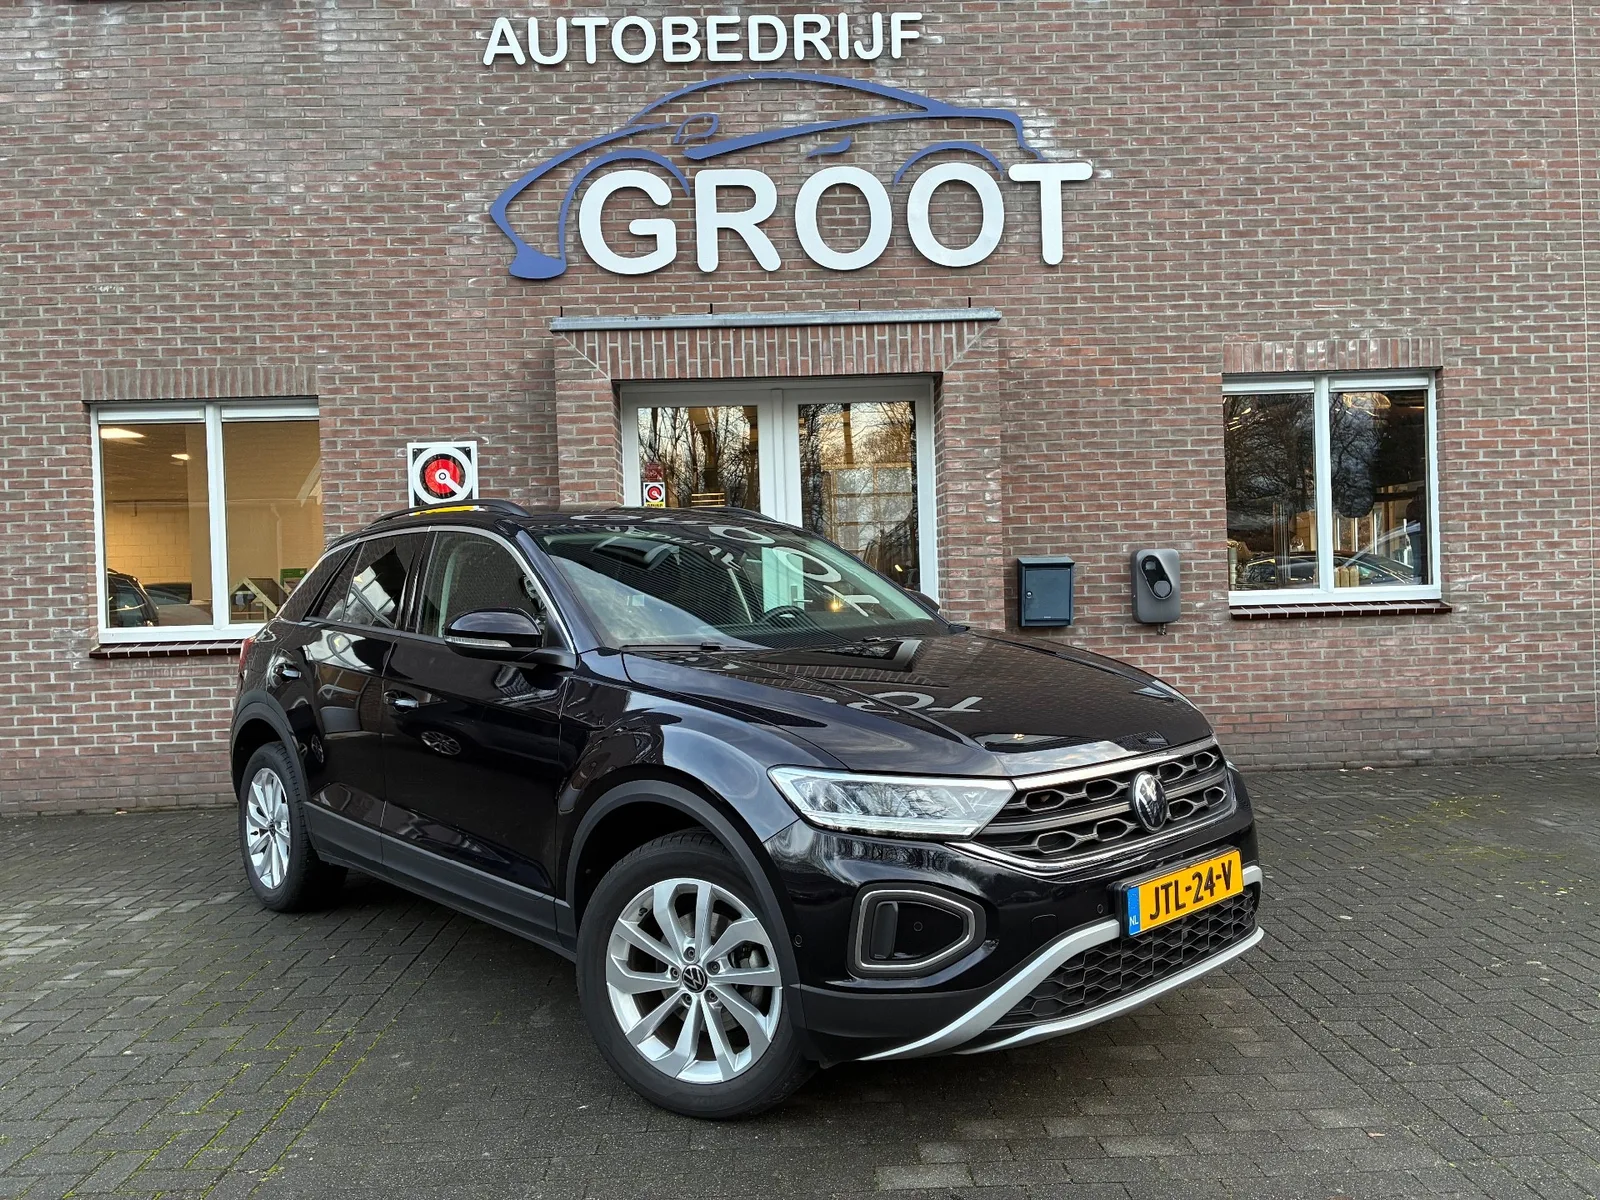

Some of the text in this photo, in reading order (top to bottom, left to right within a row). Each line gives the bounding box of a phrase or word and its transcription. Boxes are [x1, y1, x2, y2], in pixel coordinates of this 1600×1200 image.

[482, 12, 922, 66] AUTOBEDRIJF
[578, 161, 1093, 275] GROOT
[1149, 859, 1232, 921] JTL-24-V
[1129, 915, 1139, 927] NL
